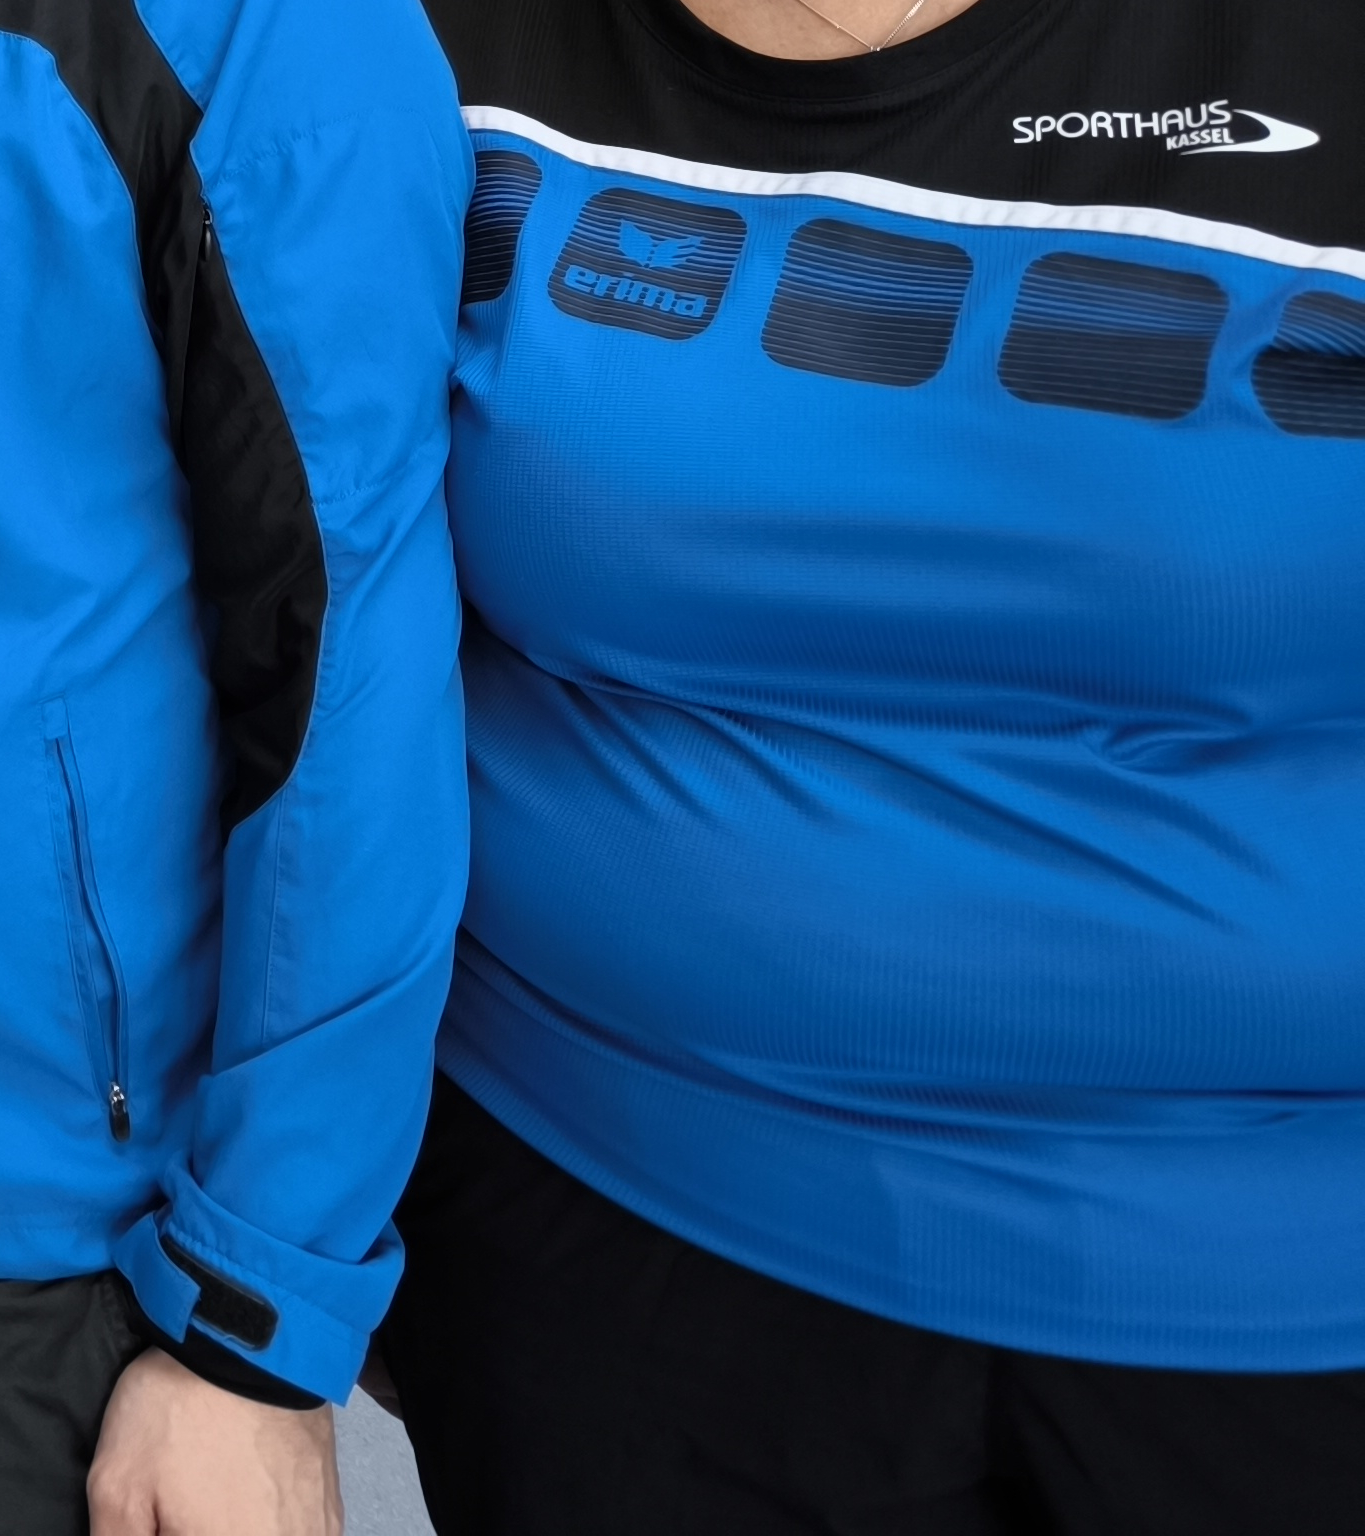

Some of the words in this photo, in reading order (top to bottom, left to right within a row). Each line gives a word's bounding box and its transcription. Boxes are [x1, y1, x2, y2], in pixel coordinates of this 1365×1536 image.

[1012, 99, 1233, 144] SPORTHAUS
[1165, 128, 1235, 151] KASSEL
[563, 264, 708, 317] erima
